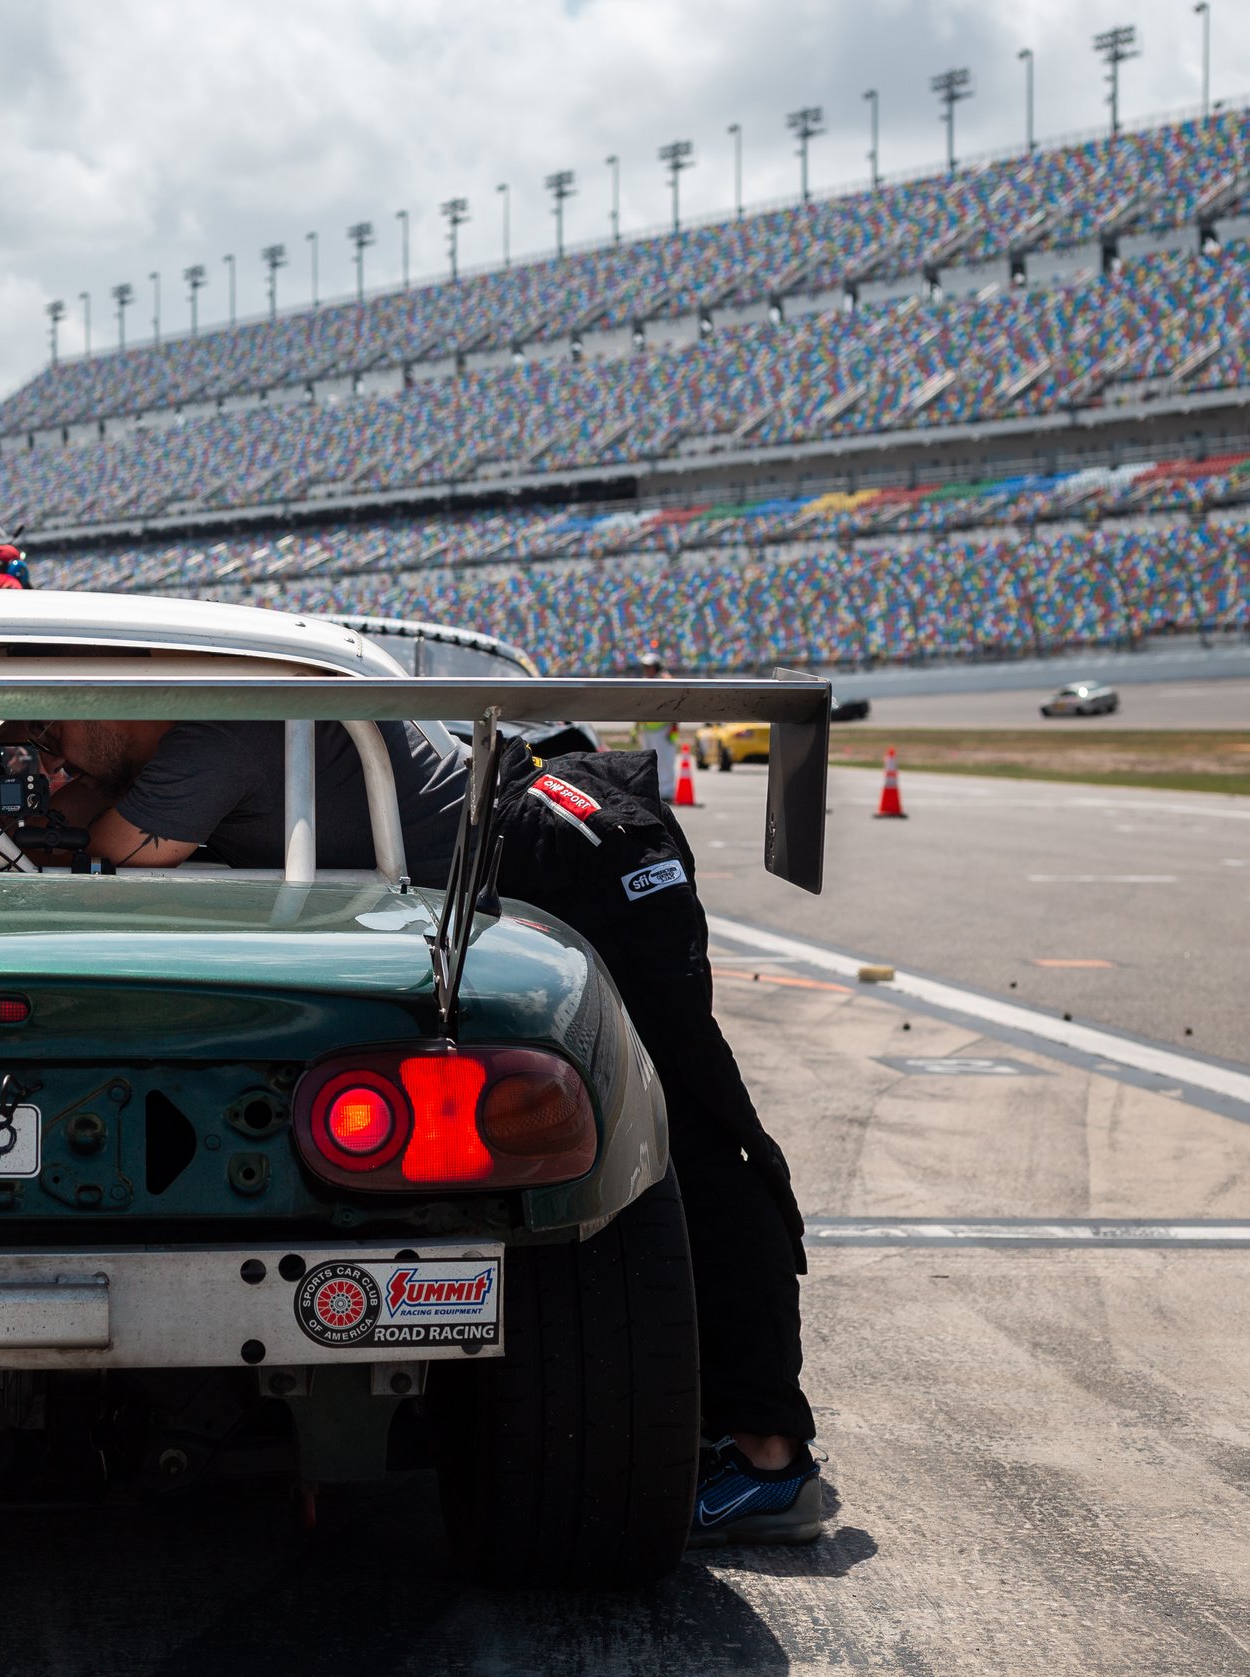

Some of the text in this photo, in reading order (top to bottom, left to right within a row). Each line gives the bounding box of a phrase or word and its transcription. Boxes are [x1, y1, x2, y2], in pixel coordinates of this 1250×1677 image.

[560, 789, 592, 810] SPORT
[632, 874, 650, 890] sfi
[302, 1266, 378, 1308] SPORTS CAR CLUB
[400, 1308, 483, 1317] RACING EQUIPMENT
[309, 1318, 373, 1340] OF AMERICA
[374, 1325, 494, 1341] ROAD RACING
